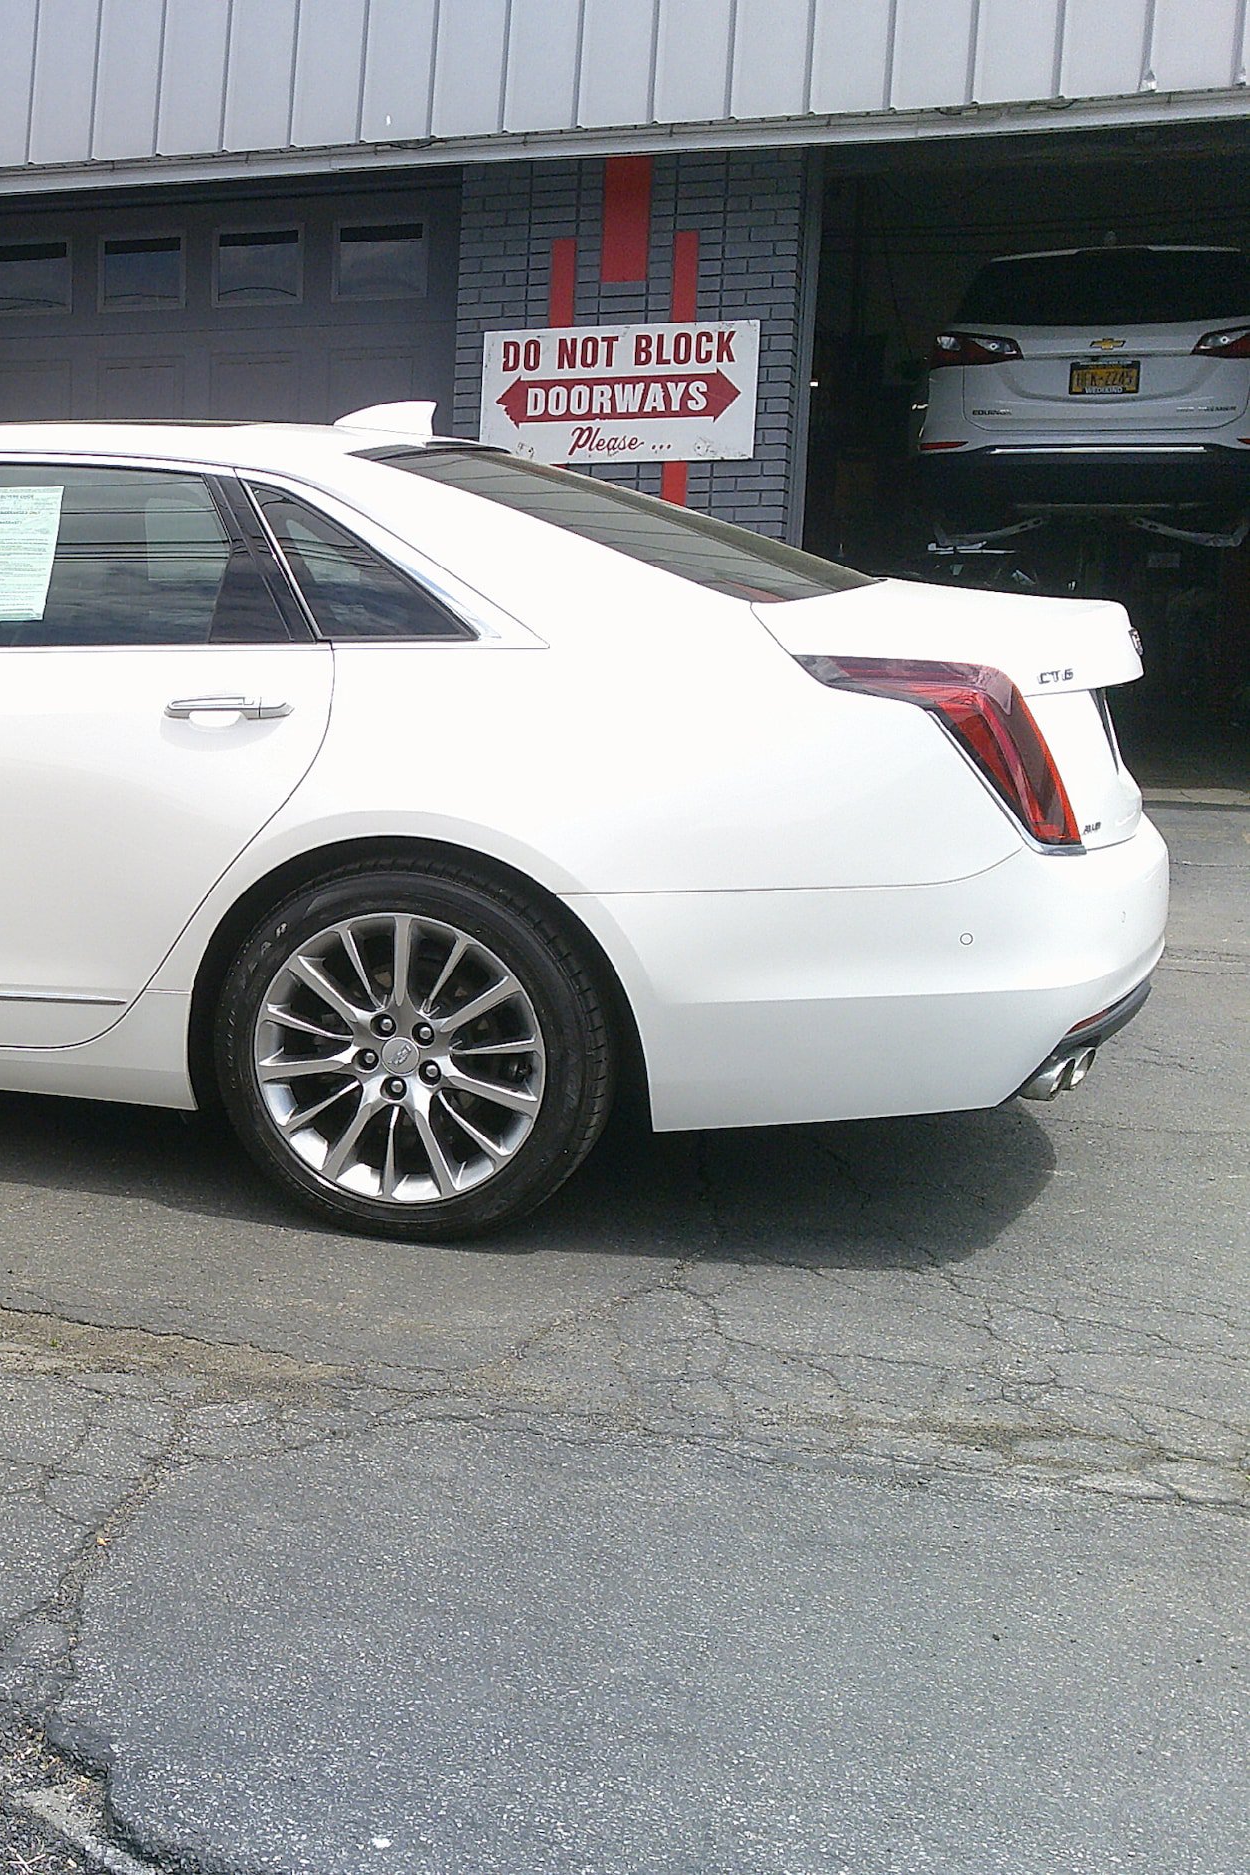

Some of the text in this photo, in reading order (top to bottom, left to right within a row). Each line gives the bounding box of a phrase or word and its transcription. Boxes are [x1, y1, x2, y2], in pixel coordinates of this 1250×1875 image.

[502, 330, 737, 372] DO NOT BLOCK
[526, 380, 709, 417] DOORWAYS
[567, 426, 645, 456] Please
